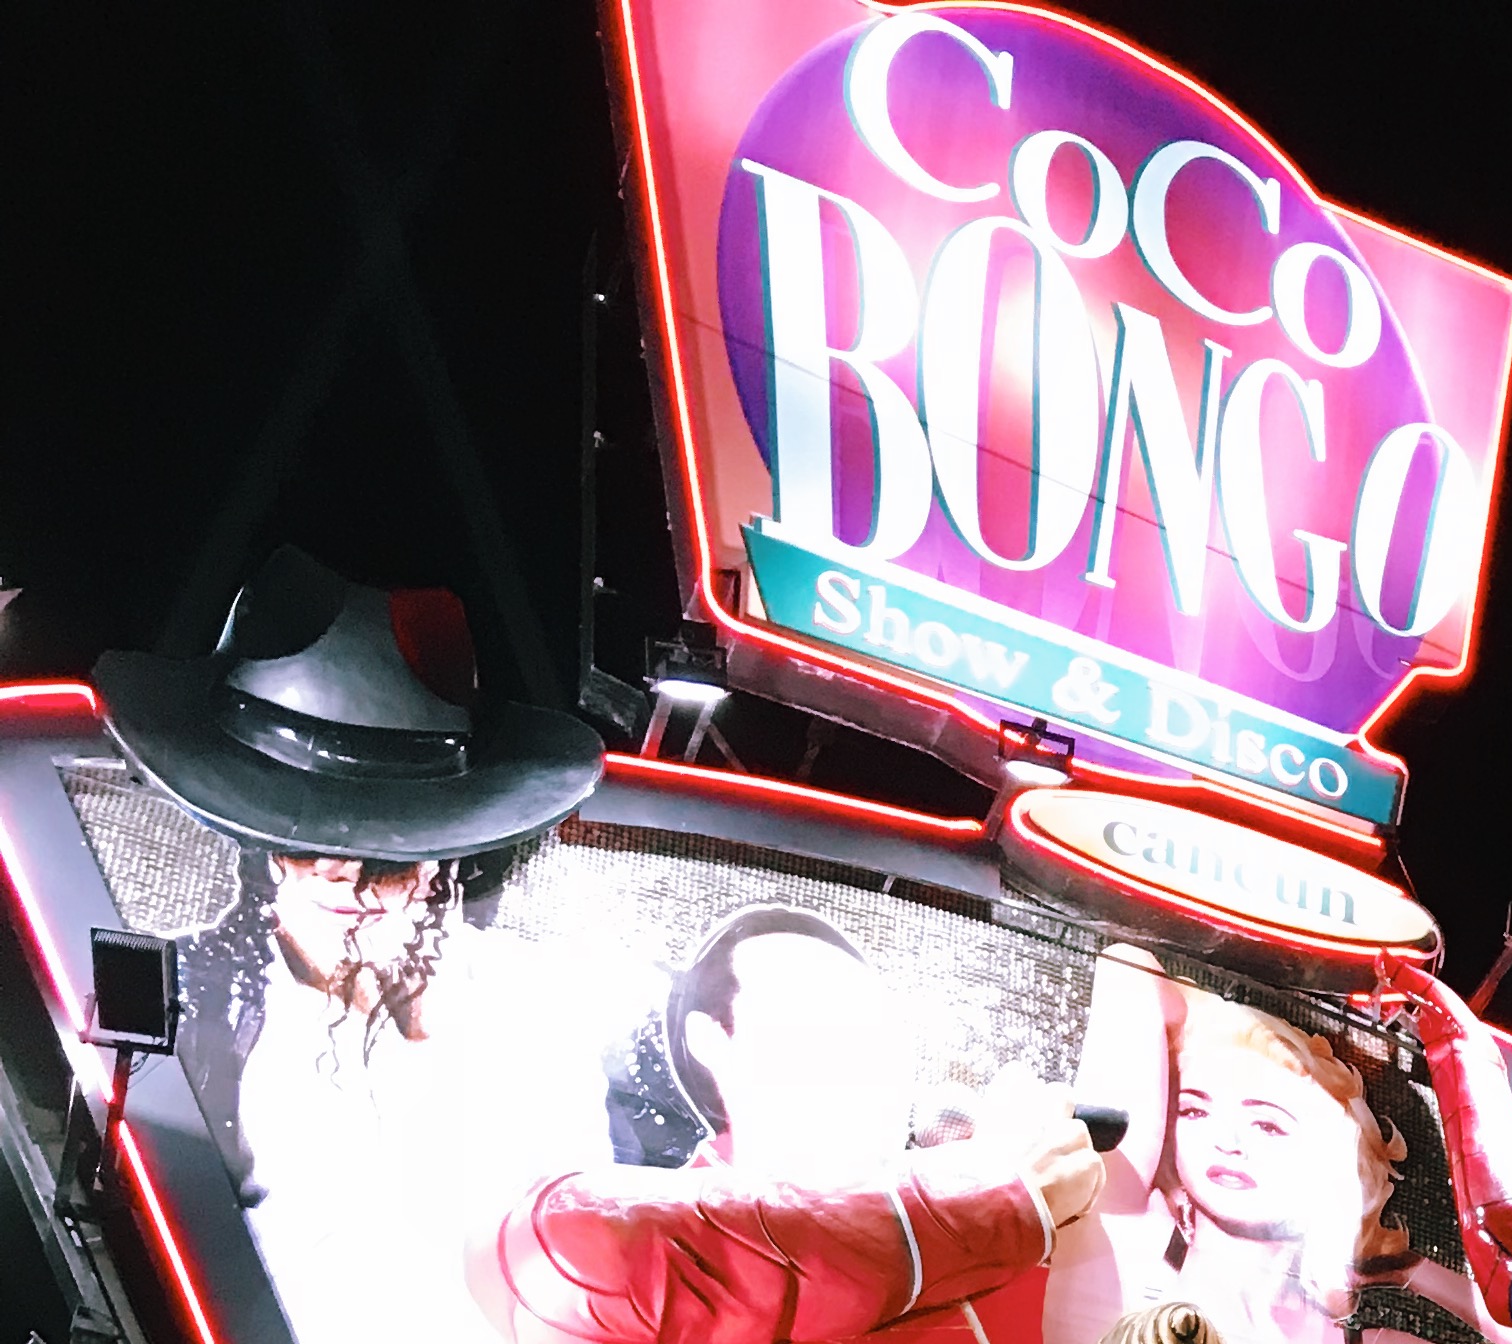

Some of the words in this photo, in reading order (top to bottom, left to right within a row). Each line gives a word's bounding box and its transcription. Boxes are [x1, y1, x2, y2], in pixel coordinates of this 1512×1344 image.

[741, 159, 1481, 637] BONGO
[812, 569, 1031, 681] Show
[1052, 655, 1122, 727] &
[1145, 677, 1349, 799] Disco
